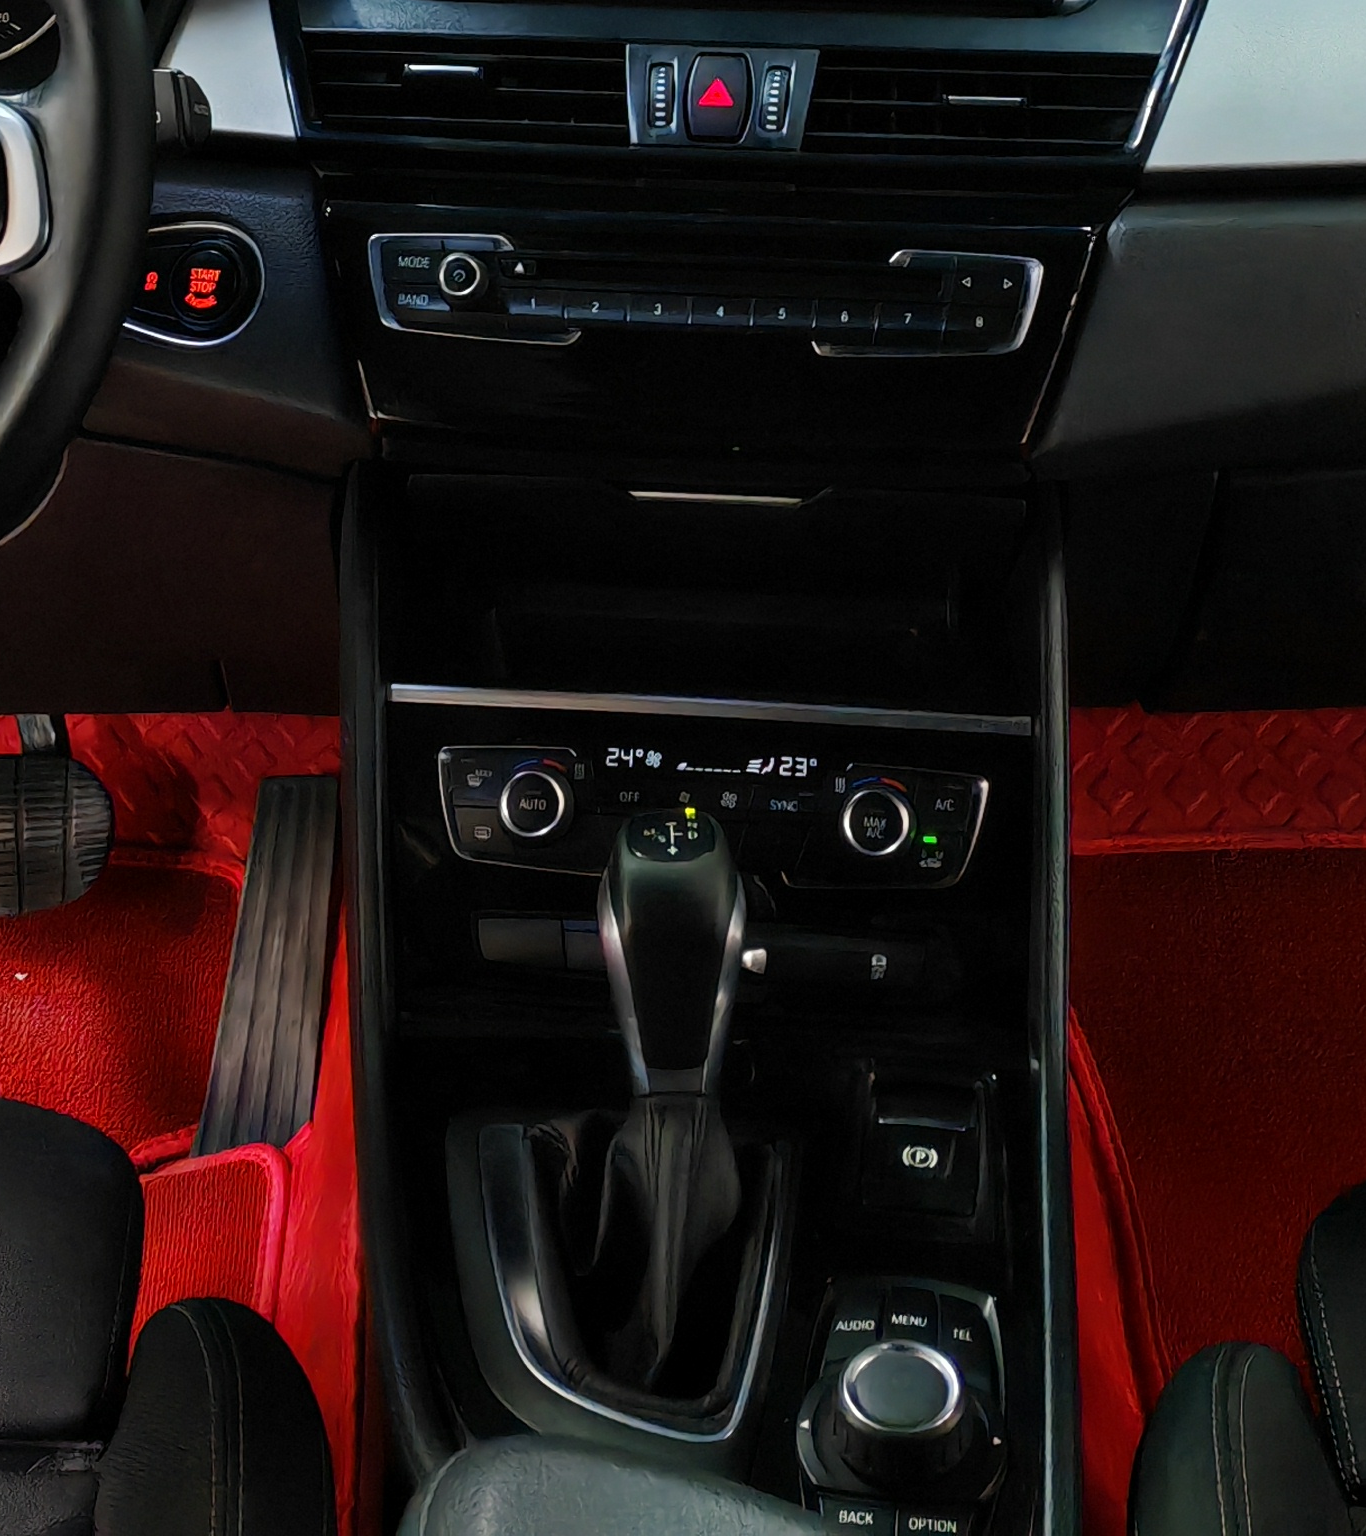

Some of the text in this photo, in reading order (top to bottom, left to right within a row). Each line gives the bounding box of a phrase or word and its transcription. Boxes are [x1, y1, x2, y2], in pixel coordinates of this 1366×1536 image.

[398, 257, 430, 268] MODE
[190, 268, 221, 282] START
[190, 281, 216, 293] STOP
[397, 293, 429, 306] BAND
[591, 301, 600, 312] 2
[653, 302, 662, 315] 3
[716, 305, 724, 317] 4
[777, 307, 786, 320] 5
[840, 311, 849, 323] 6
[903, 313, 912, 325] 7
[975, 316, 983, 328] 8
[619, 791, 641, 803] OFF
[519, 797, 547, 811] AUTO
[769, 800, 799, 812] SYNC
[935, 798, 955, 812] A/C
[863, 816, 887, 829] MAX
[835, 1320, 876, 1332] AUDIO
[891, 1313, 928, 1327] MENU
[953, 1327, 973, 1342] TEL
[838, 1509, 874, 1525] BACK
[908, 1517, 958, 1533] OPTION
